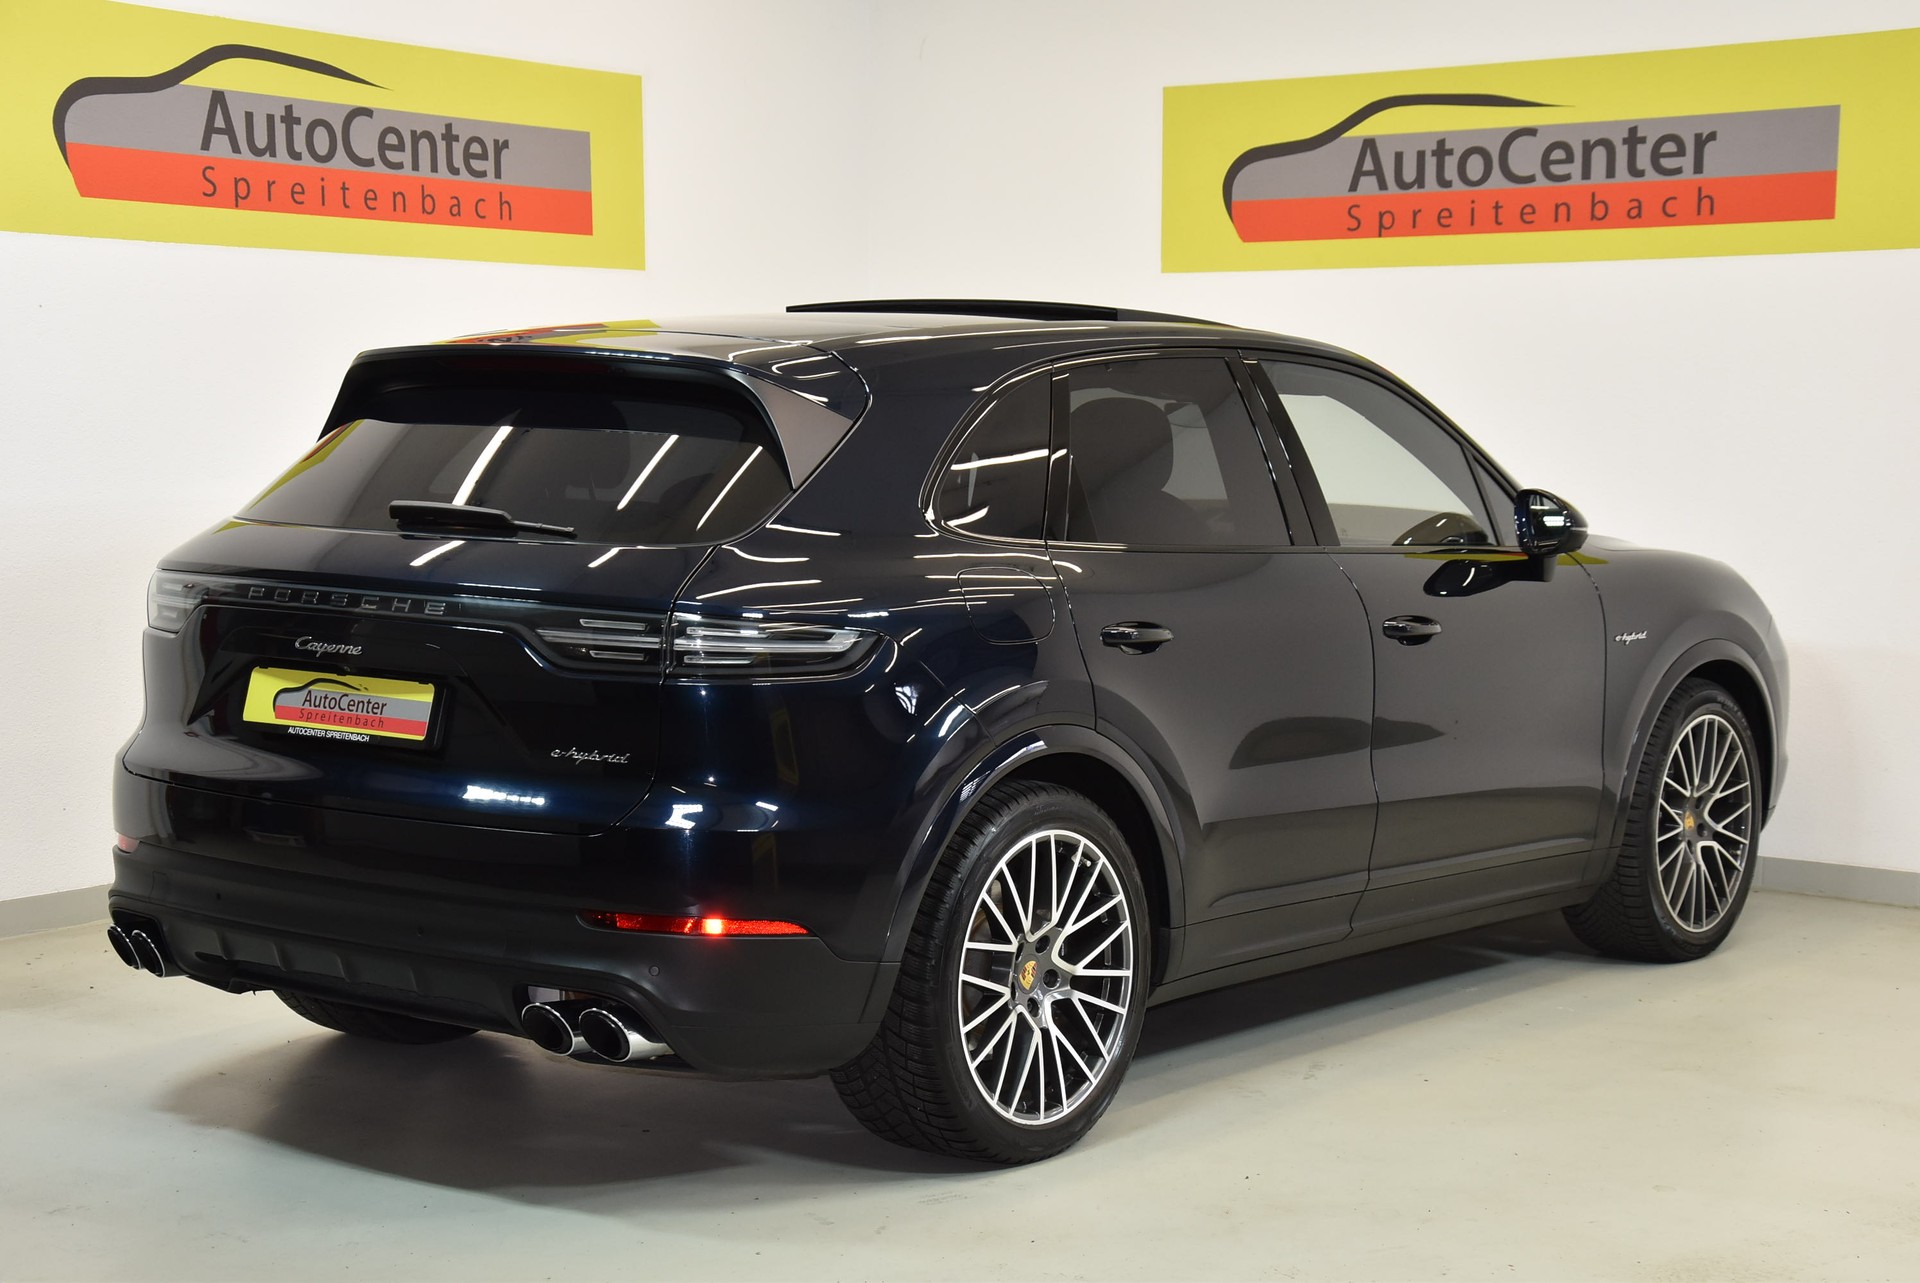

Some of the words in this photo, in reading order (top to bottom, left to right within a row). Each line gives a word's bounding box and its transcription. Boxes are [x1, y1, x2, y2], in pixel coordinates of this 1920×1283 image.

[200, 89, 510, 180] AutoCenter
[1347, 125, 1718, 193] AutoCenter
[201, 165, 512, 221] Spreitenbach
[1346, 186, 1715, 238] Spreitenbach
[248, 586, 447, 616] PORSCHE
[294, 636, 363, 658] Cayenne
[302, 689, 388, 716] AutoCenter
[299, 708, 385, 728] Spreitenbach
[287, 726, 326, 737] AUTOCENTER
[326, 730, 370, 743] SPREITENBACH
[550, 746, 631, 766] e-hybrid
